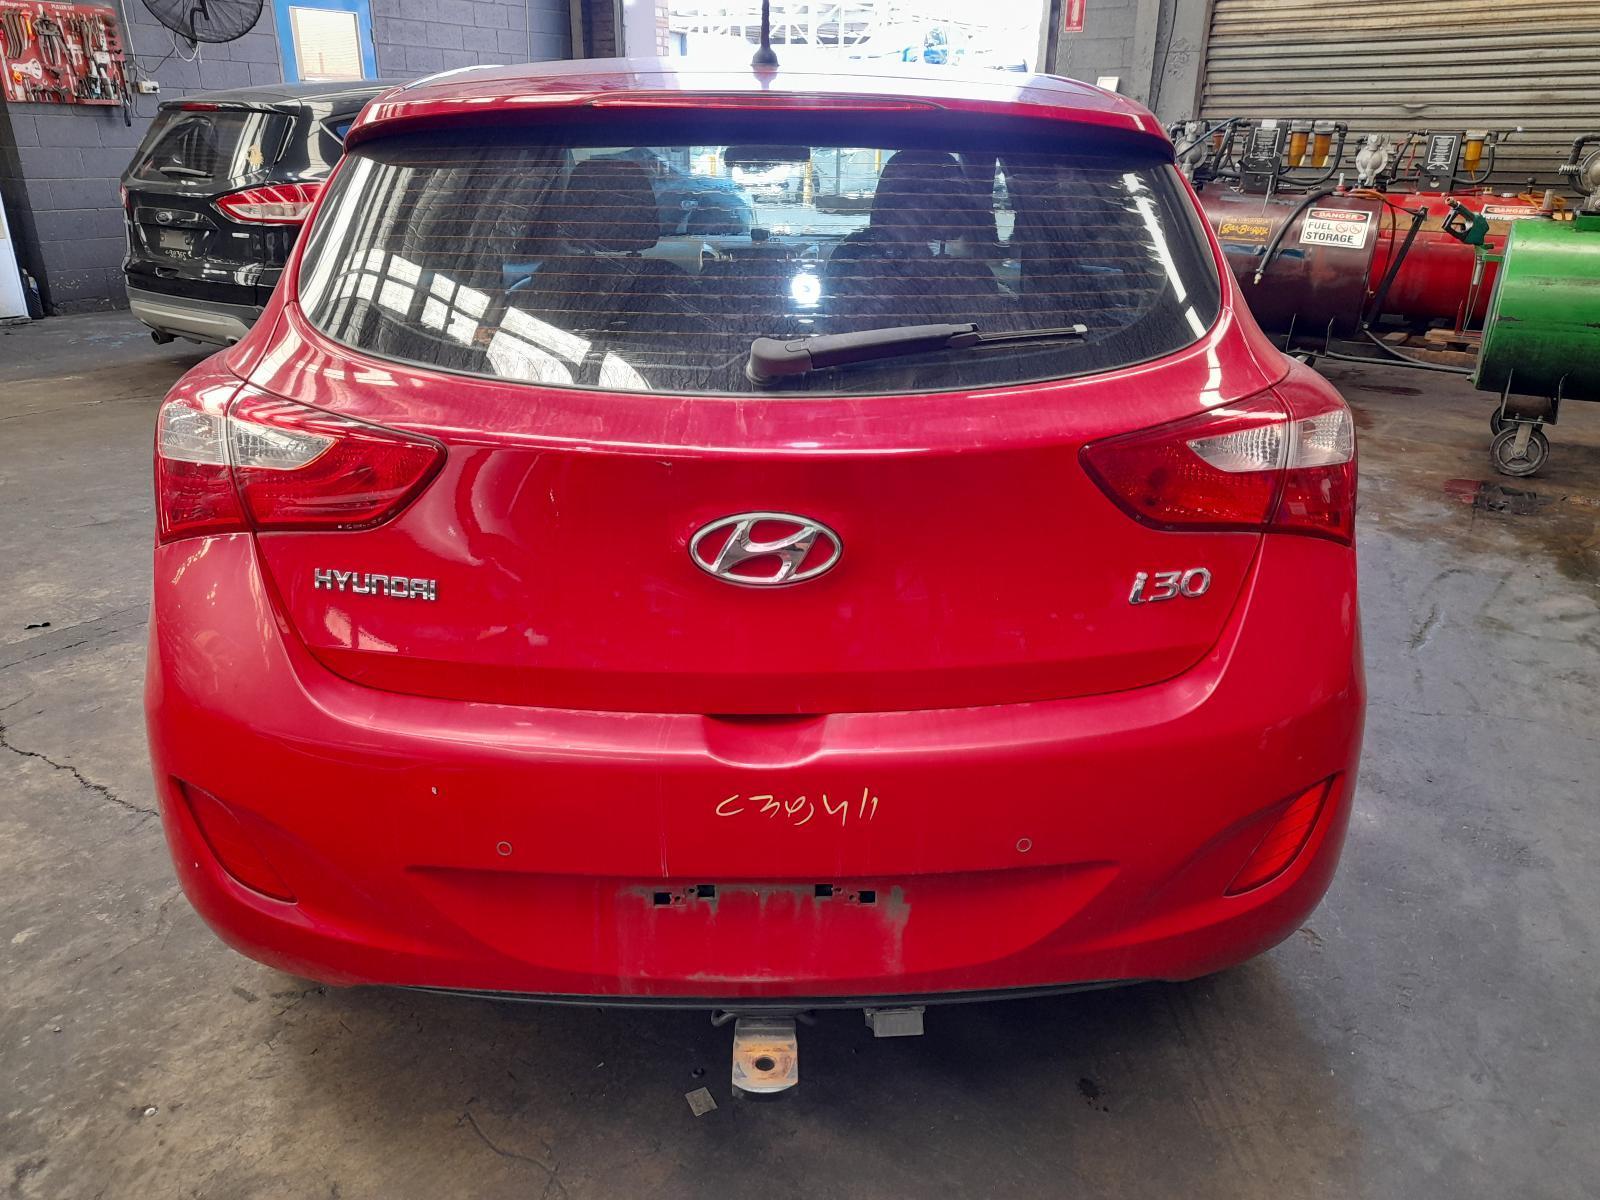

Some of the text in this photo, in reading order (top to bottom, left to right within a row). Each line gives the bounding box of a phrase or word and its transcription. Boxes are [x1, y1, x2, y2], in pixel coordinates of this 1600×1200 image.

[1319, 212, 1358, 220] DANGER
[1308, 221, 1332, 231] FUEL
[1306, 231, 1354, 244] STORAGE
[314, 567, 436, 601] HYUNDAI
[1128, 567, 1212, 605] i30
